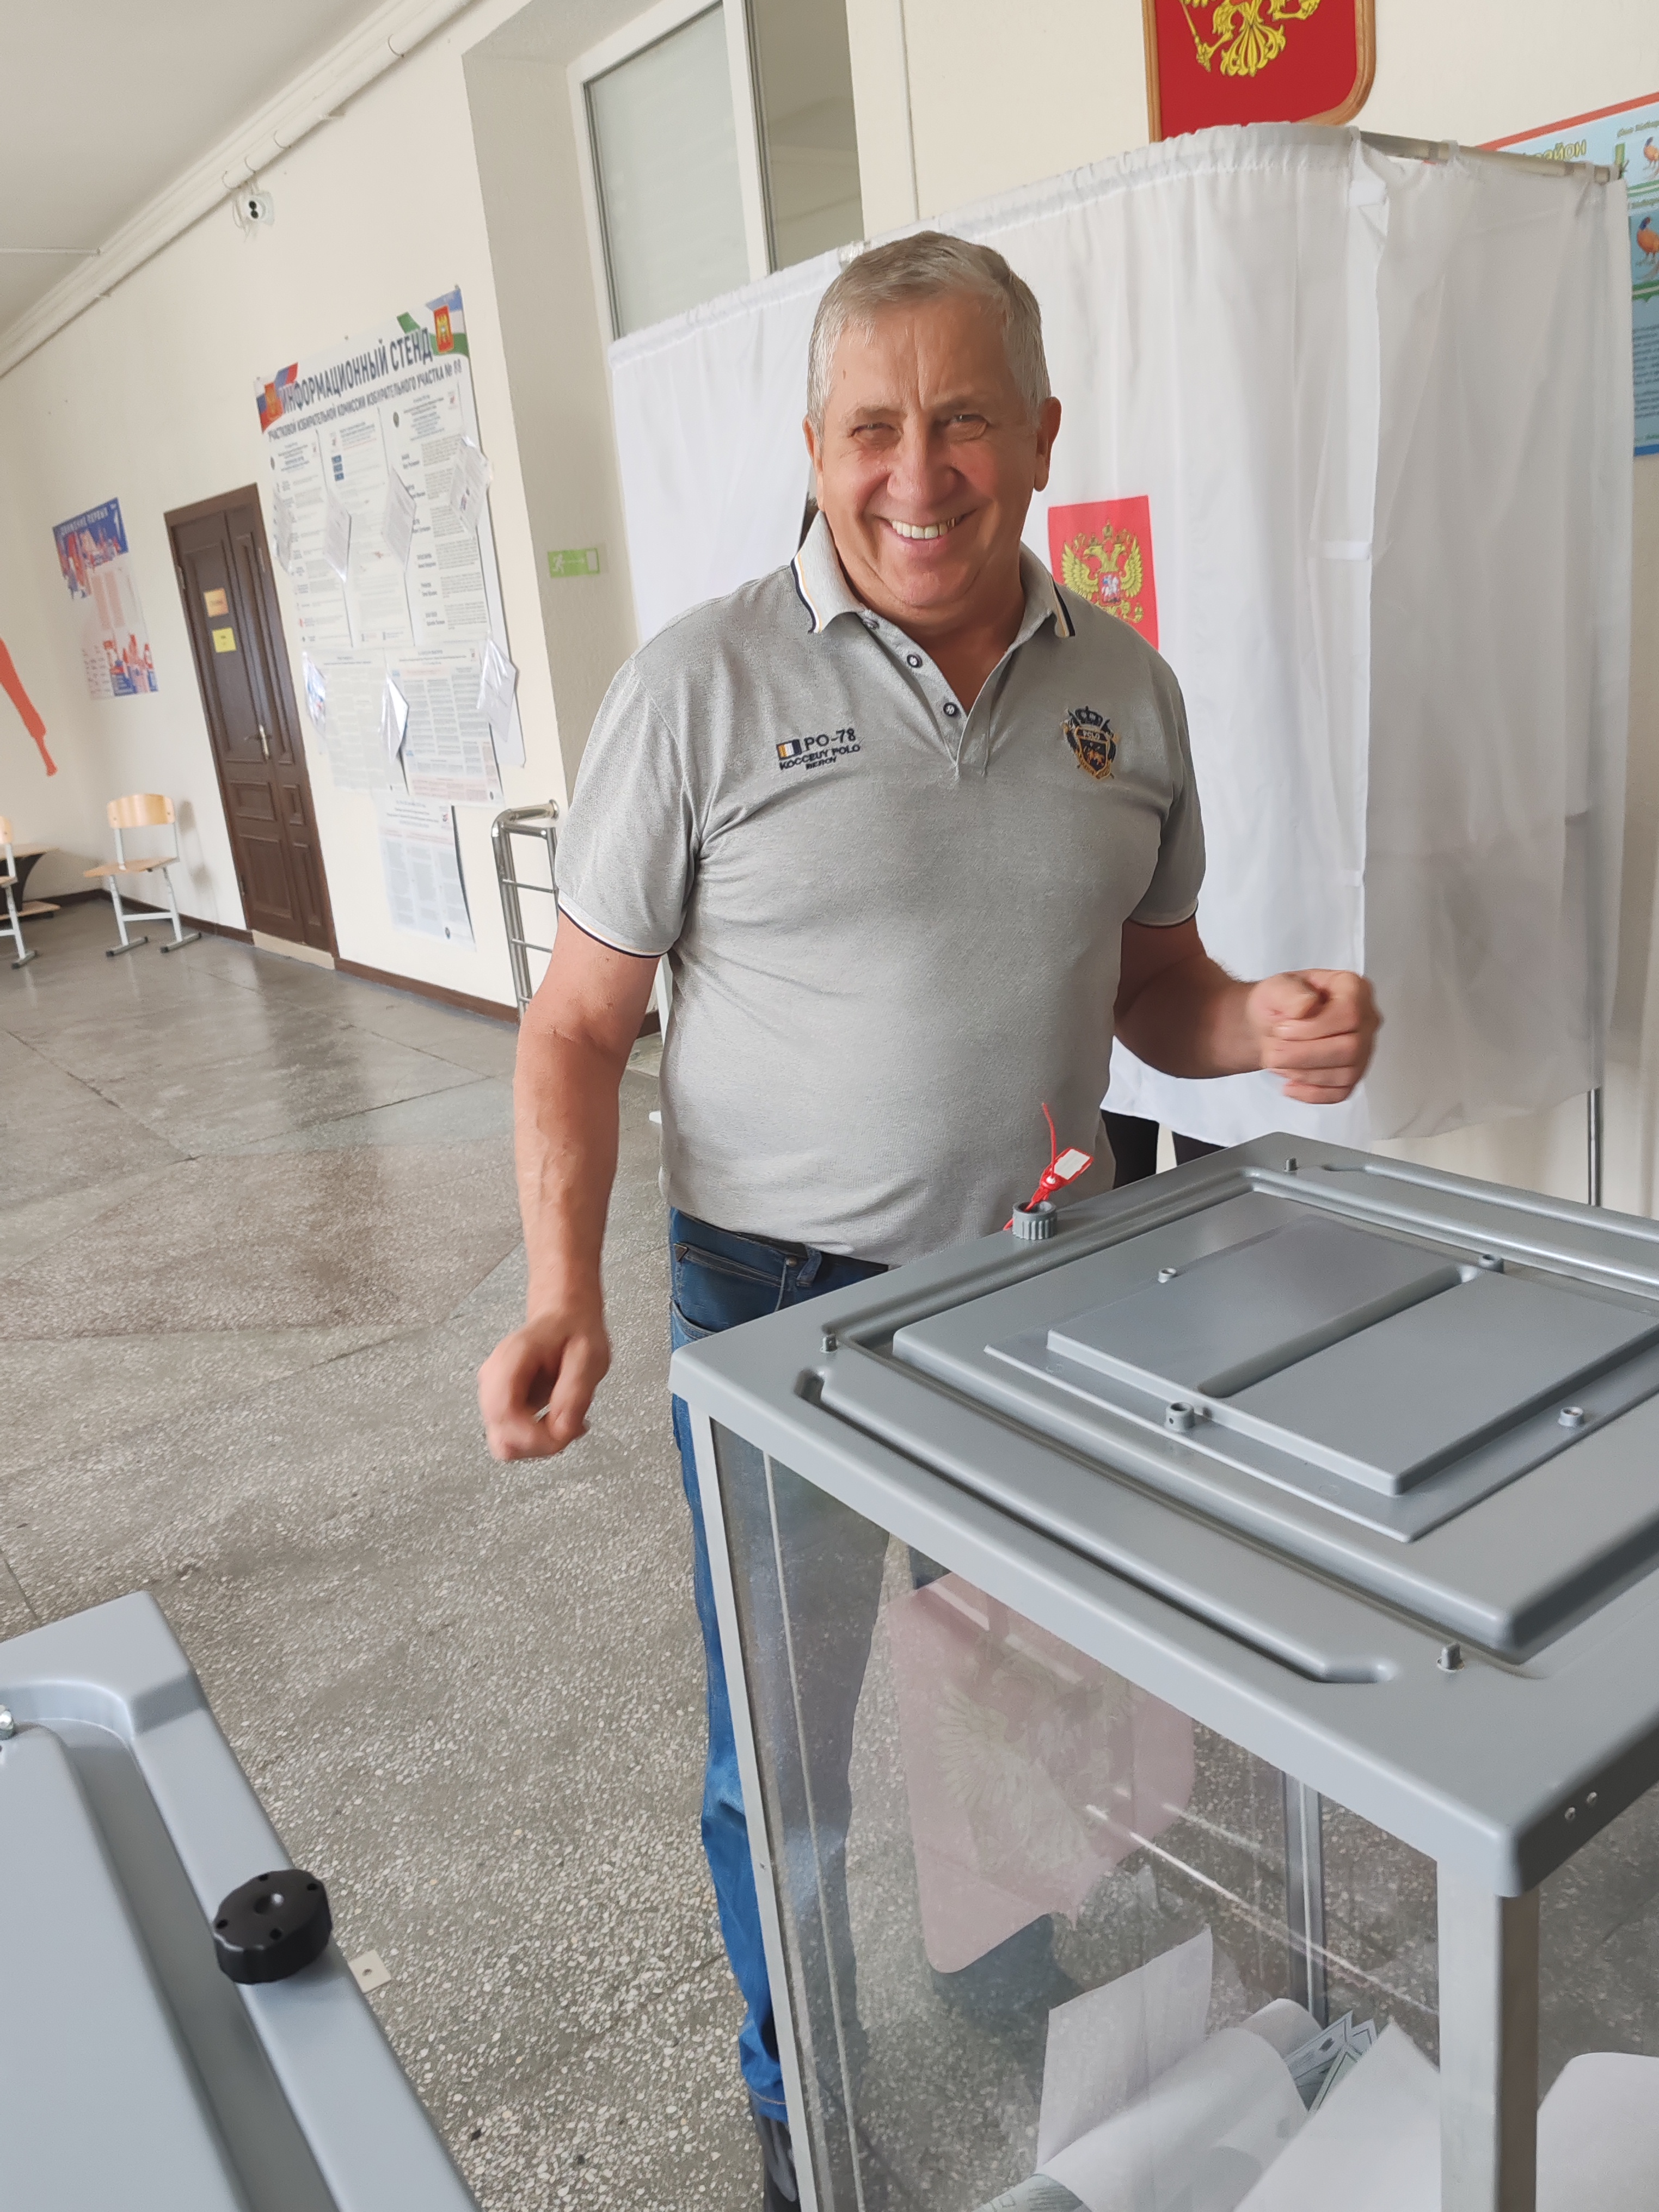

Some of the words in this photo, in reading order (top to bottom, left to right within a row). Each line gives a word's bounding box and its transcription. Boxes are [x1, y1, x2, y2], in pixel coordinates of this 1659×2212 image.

[278, 339, 389, 414] ИНФОРМАЦИОННЫЙ
[390, 327, 433, 372] СТЕНД
[804, 727, 856, 751] PO-78
[831, 744, 861, 755] POLO
